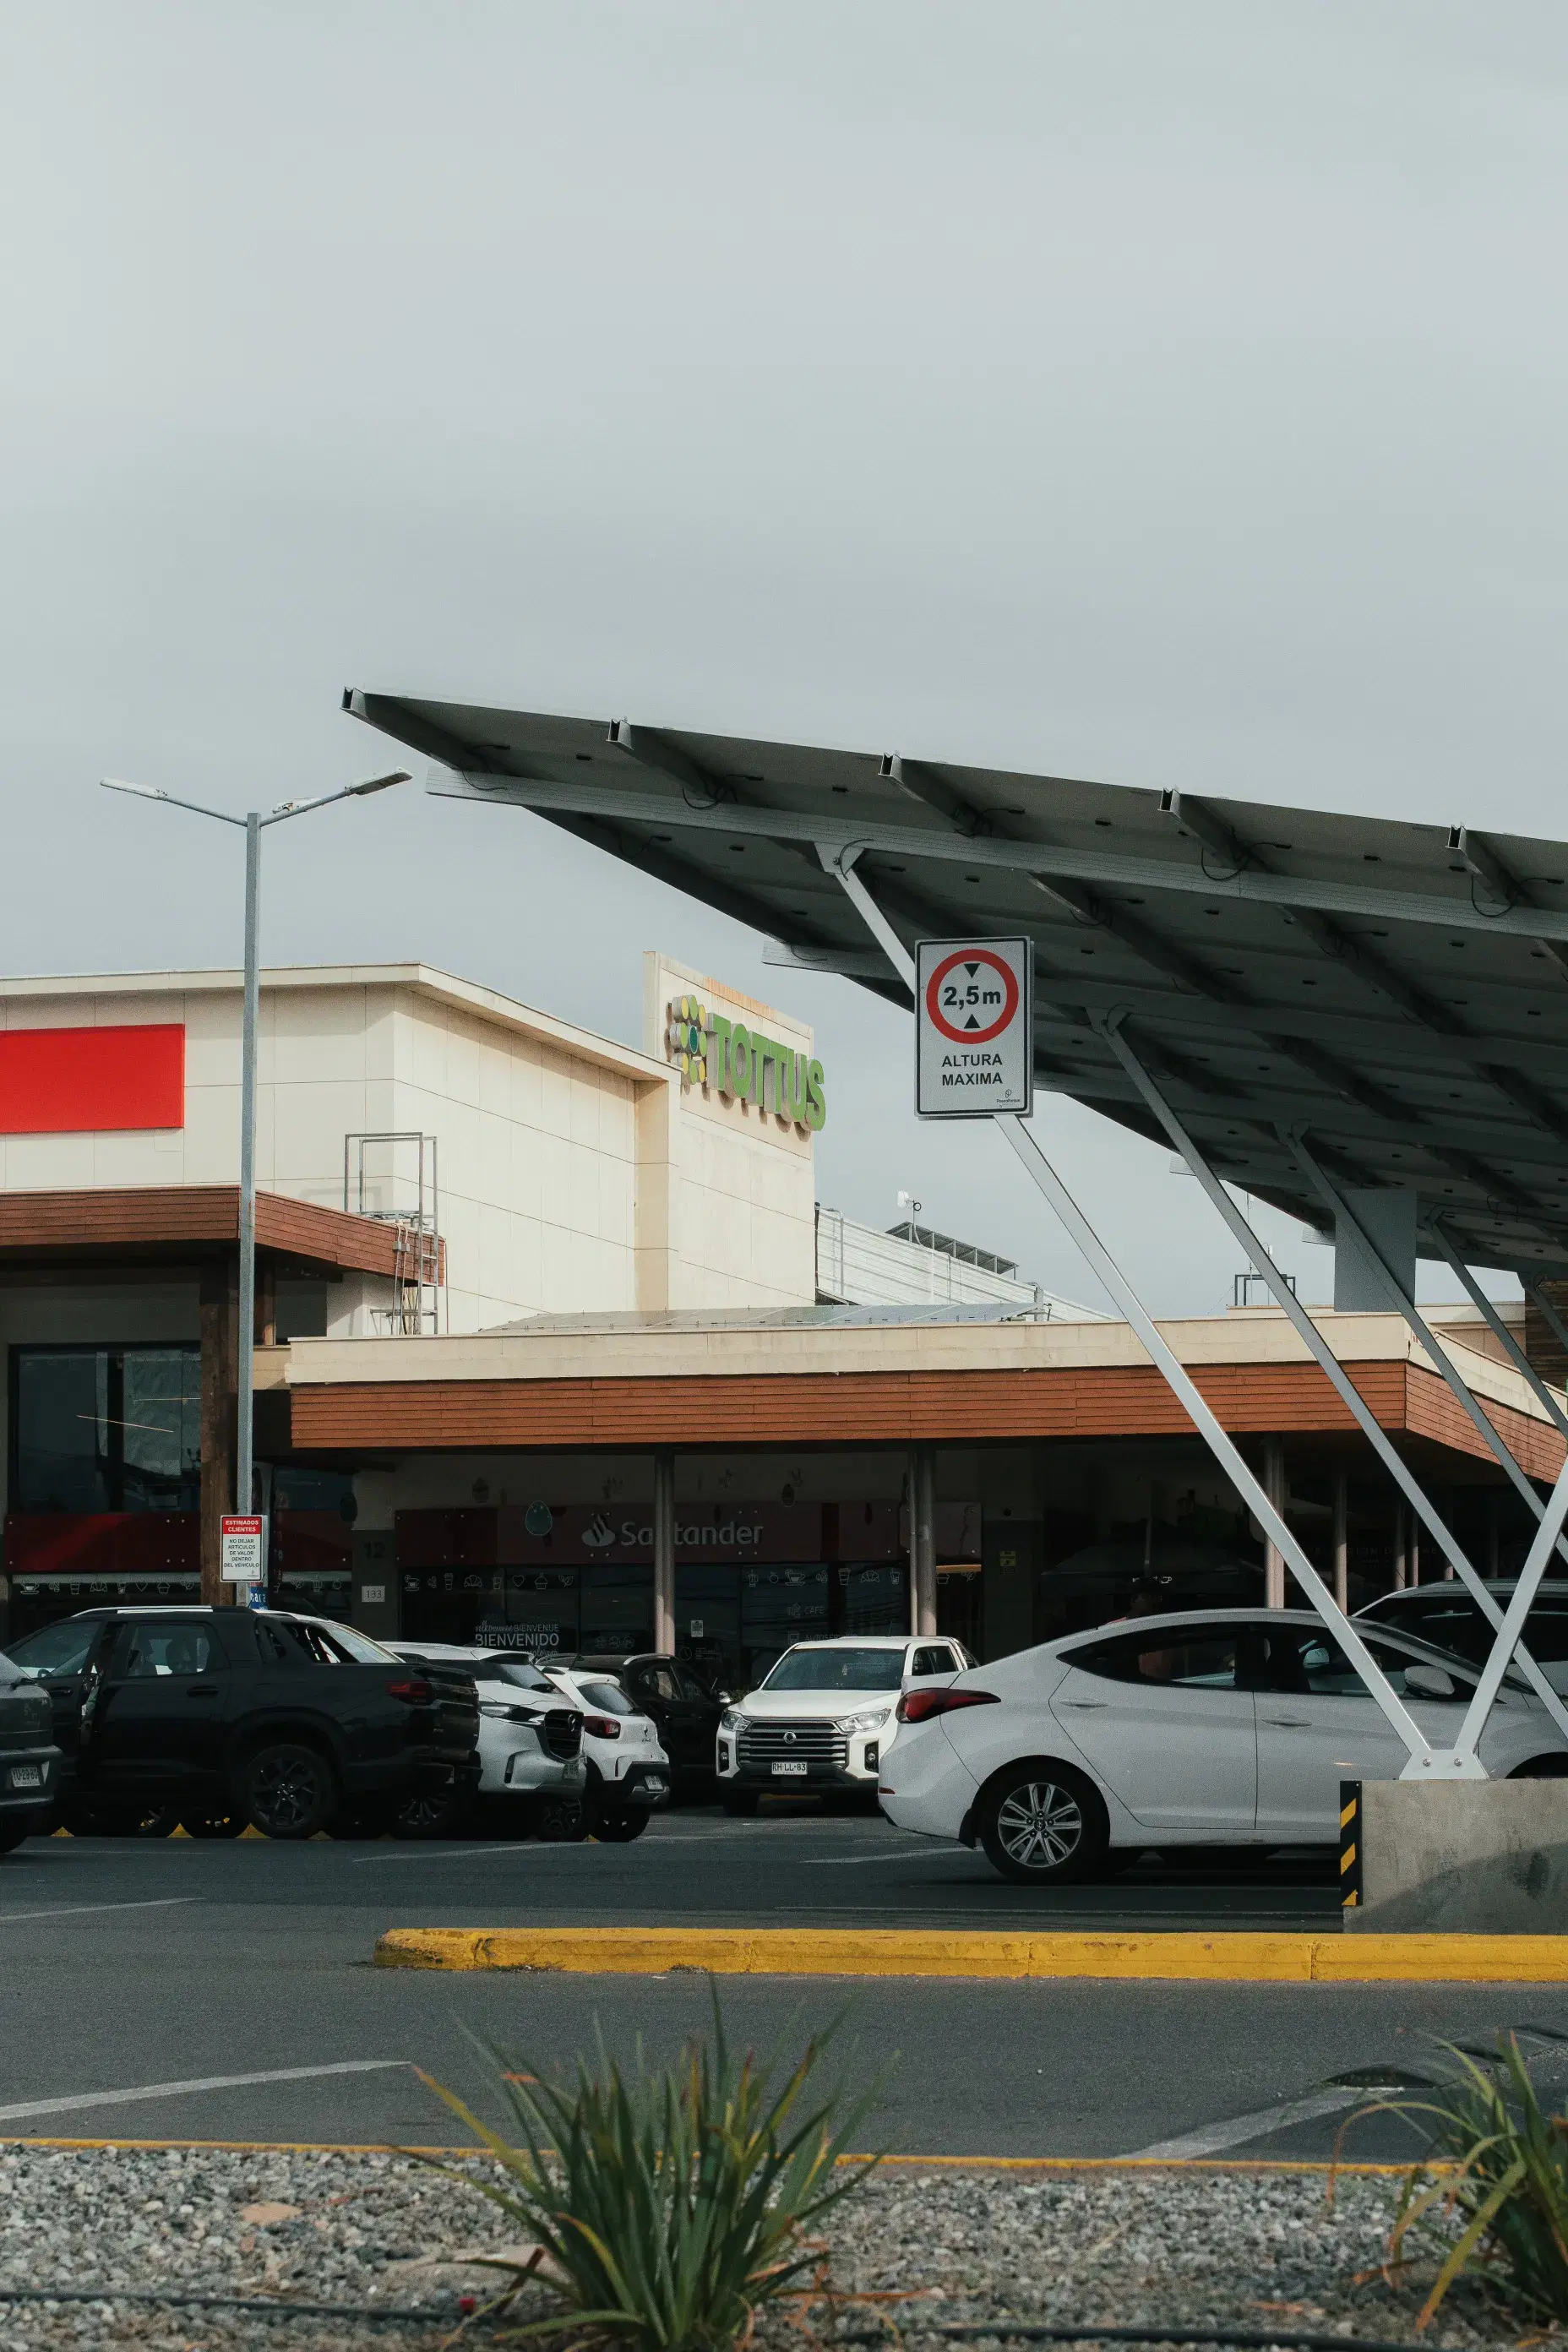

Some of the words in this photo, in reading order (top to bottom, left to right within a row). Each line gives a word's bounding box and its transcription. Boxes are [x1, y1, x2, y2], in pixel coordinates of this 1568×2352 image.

[941, 1053, 1003, 1068] ALTURA
[703, 1013, 826, 1132] TOTTUS
[941, 1072, 1003, 1086] MAXIMA
[621, 1520, 764, 1547] Satander
[366, 1589, 382, 1598] 133
[514, 1624, 560, 1632] BIENVENUE
[475, 1633, 560, 1647] BIENVENIDO
